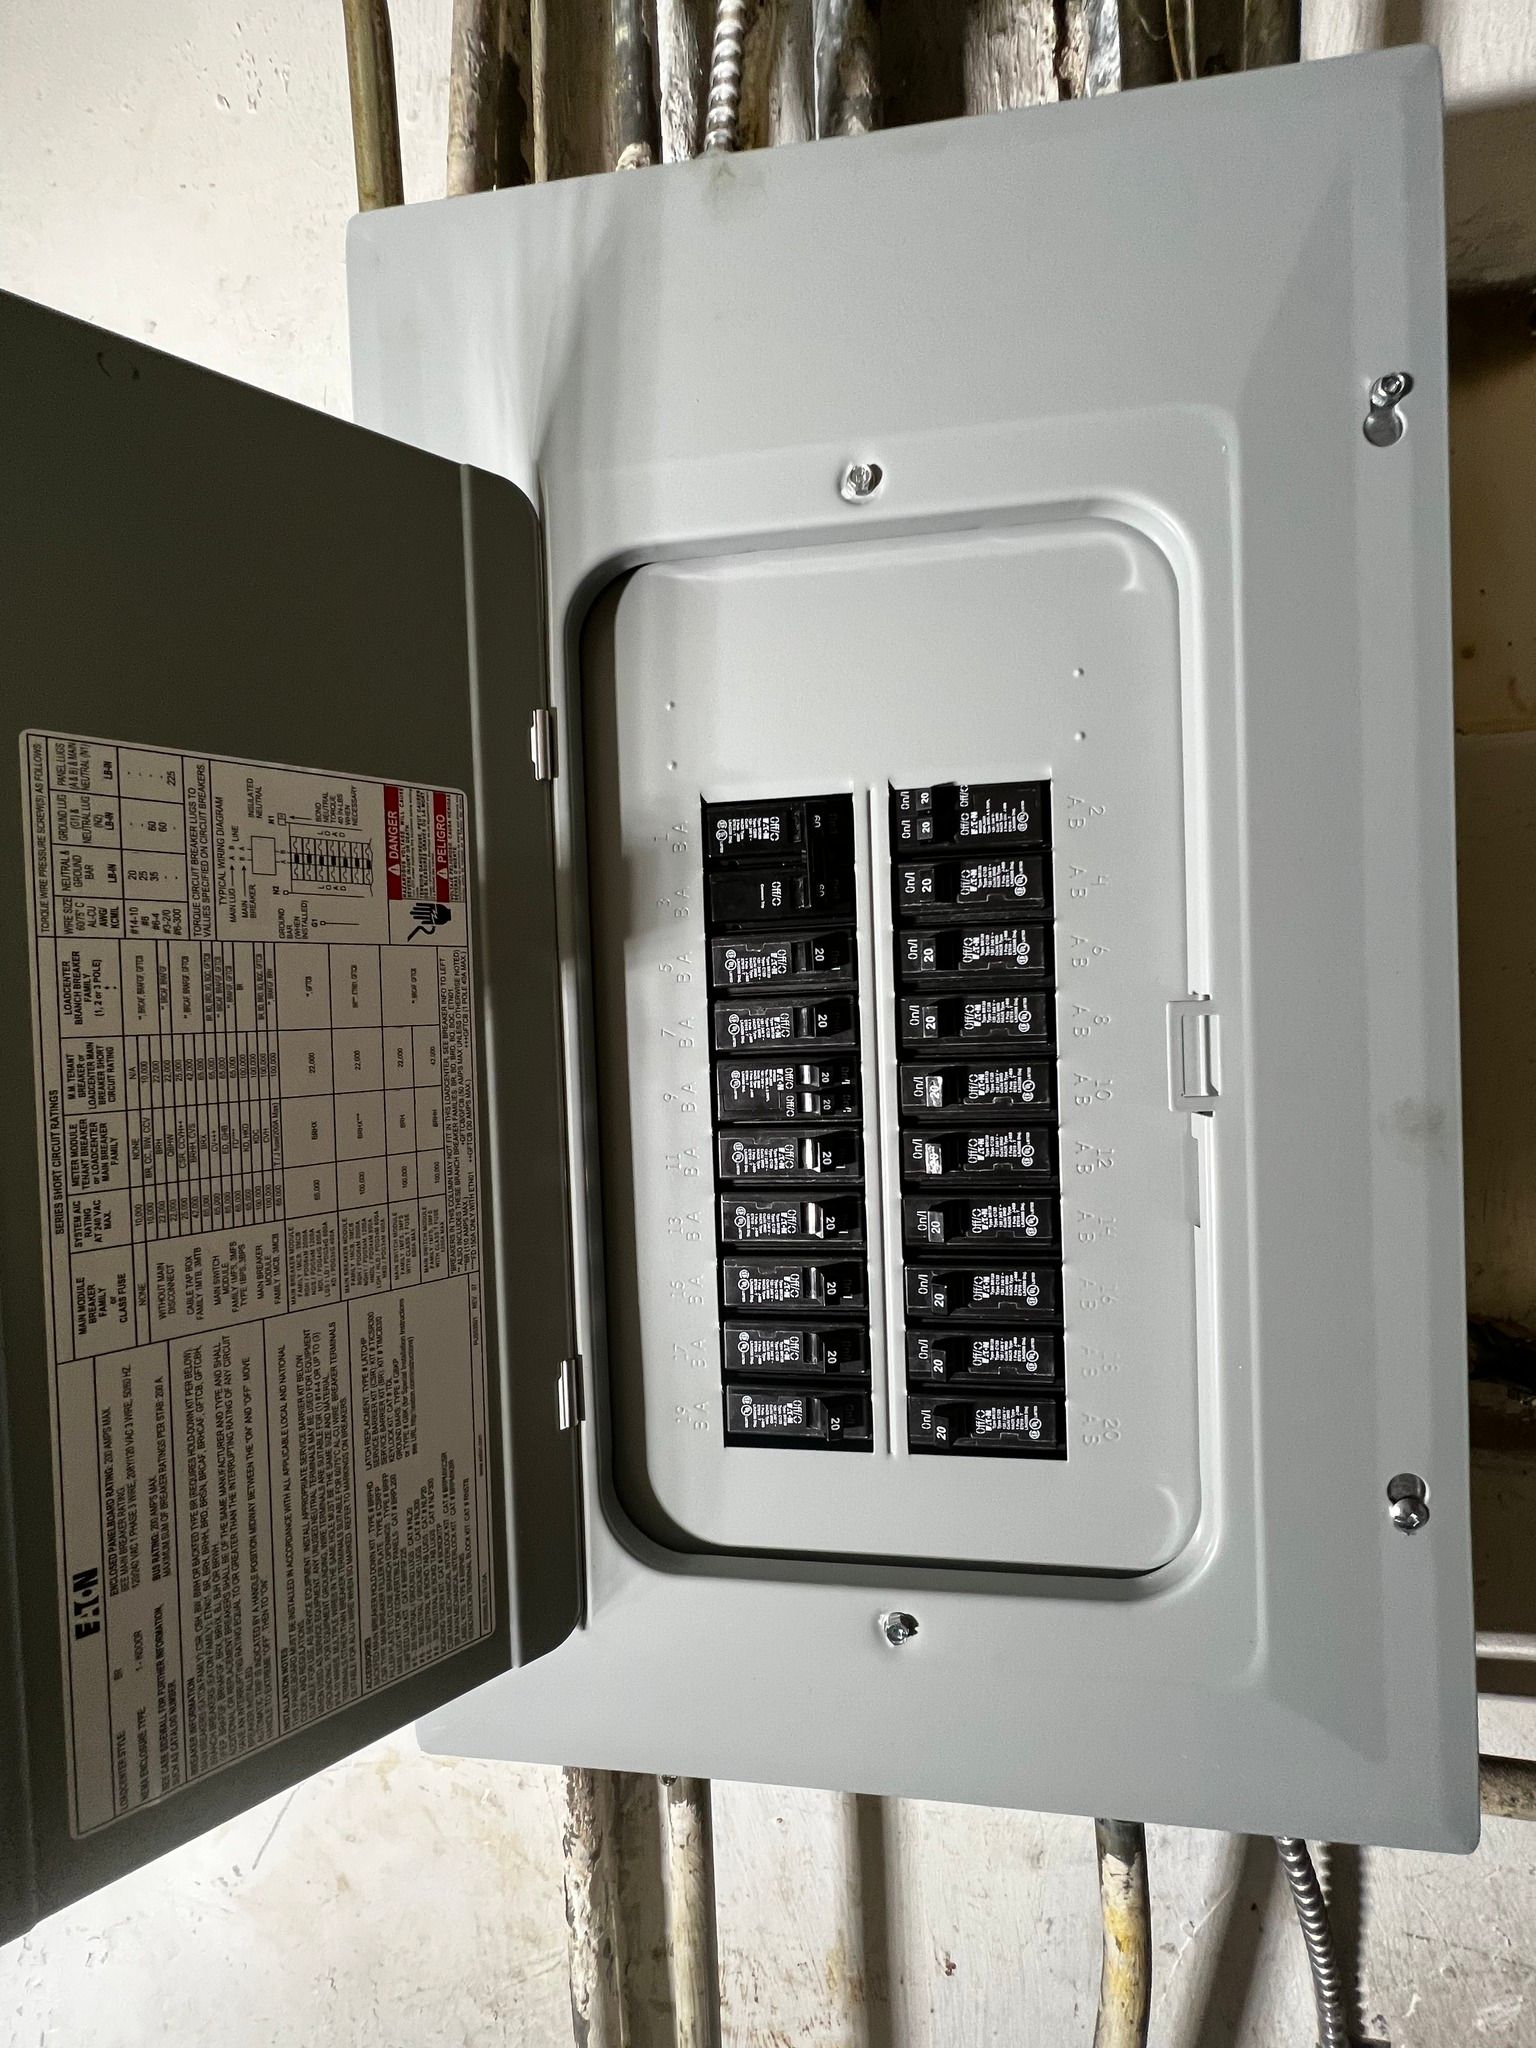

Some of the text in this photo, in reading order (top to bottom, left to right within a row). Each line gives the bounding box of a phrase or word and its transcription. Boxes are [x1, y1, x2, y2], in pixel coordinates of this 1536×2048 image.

[54, 743, 66, 786] PANEL LUGS
[79, 759, 90, 791] NEUTRAL
[102, 761, 112, 780] LB-IN
[34, 783, 44, 794] AS
[166, 771, 175, 786] 225
[246, 778, 254, 819] INSULATED
[921, 793, 929, 804] 20
[34, 795, 46, 834] SCREW(S)
[56, 794, 68, 841] GROUND LUG
[81, 796, 92, 844] NEUTRAL LUG
[104, 812, 114, 831] LB-IN
[1089, 806, 1106, 816] 2
[147, 821, 156, 832] 60
[158, 822, 167, 833] 60
[198, 811, 207, 844] CIRCUIT
[387, 811, 398, 860] DANGER
[922, 822, 930, 833] 20
[436, 815, 446, 863] PELIGRO
[36, 835, 48, 878] PRESSURE
[187, 788, 201, 936] TORQUE CIRCUIT BREAKER LUGS TO
[200, 846, 208, 859] ON
[215, 797, 227, 906] TYPICAL WIRING DIAGRAM
[60, 859, 71, 891] NEUTRAL
[72, 855, 83, 888] GROUND
[84, 865, 94, 880] BAR
[107, 864, 117, 883] LB-IN
[128, 871, 137, 880] 20
[139, 871, 148, 881] 25
[150, 872, 158, 882] 35
[200, 861, 210, 904] SPECIFIED
[38, 880, 49, 899] WIRE
[921, 878, 932, 892] 20
[248, 885, 256, 919] BREAKER
[657, 898, 670, 906] 3
[39, 901, 51, 932] TORQUE
[62, 898, 73, 935] WIRE SIZE
[86, 906, 96, 928] AL-CU
[98, 907, 108, 927] AWG/
[109, 907, 119, 929] KCMIL
[129, 907, 139, 934] #14-10
[162, 910, 172, 934] #3-2/0
[202, 906, 211, 937] VALUES
[815, 948, 825, 961] 20
[923, 948, 934, 962] 20
[1093, 944, 1110, 955] 6
[92, 960, 103, 983] POLE)
[658, 963, 672, 972] 5
[61, 961, 72, 1015] LOADCENTER
[71, 952, 83, 1025] BRANCH BREAKER
[82, 974, 92, 1003] FAMILY
[818, 1014, 828, 1028] 20
[925, 1016, 936, 1030] 20
[1093, 1015, 1111, 1024] 8
[661, 1028, 674, 1038] 7
[65, 1054, 76, 1100] M.M. TENANT
[76, 1064, 86, 1099] BREAKER
[85, 1042, 97, 1110] LOADCENTER MAIN
[96, 1046, 106, 1105] BREAKER SHORT
[105, 1047, 116, 1103] CIRCUIT RATING
[128, 1067, 136, 1080] N/A
[821, 1072, 830, 1082] 20
[664, 1093, 678, 1102] 9
[930, 1085, 940, 1098] 20
[1095, 1079, 1112, 1100] 10
[822, 1099, 831, 1110] 20
[69, 1124, 80, 1187] METER MODULE
[79, 1119, 90, 1190] TENANT BREAKER
[89, 1122, 99, 1175] LOADCENTER
[99, 1124, 109, 1182] MAIN BREAKER
[110, 1138, 119, 1166] FAMILY
[131, 1138, 140, 1160] NONE
[823, 1152, 832, 1165] 20
[1098, 1149, 1114, 1167] 12
[48, 1090, 65, 1236] SERIES SHORT CIRCUIT RATINGS
[72, 1201, 83, 1248] SYSTEM AIC
[83, 1209, 93, 1238] RATING
[92, 1200, 103, 1244] AT 240 VAC
[134, 1204, 143, 1228] 10,000
[826, 1217, 836, 1230] 20
[931, 1221, 940, 1234] 20
[138, 1283, 146, 1307] NONE
[156, 1262, 166, 1321] WITHOUT MAIN
[166, 1264, 176, 1315] DISCONNECT
[184, 1256, 194, 1316] CABLE TAP BOX
[827, 1282, 836, 1295] 20
[76, 1277, 87, 1335] MAIN MODULE
[87, 1284, 97, 1325] BREAKER
[97, 1288, 107, 1318] FAMILY
[117, 1273, 128, 1324] CLASS FUSE
[934, 1293, 944, 1308] 20
[828, 1351, 836, 1363] 20
[933, 1359, 944, 1374] 20
[830, 1418, 840, 1430] 20
[936, 1426, 946, 1440] 20
